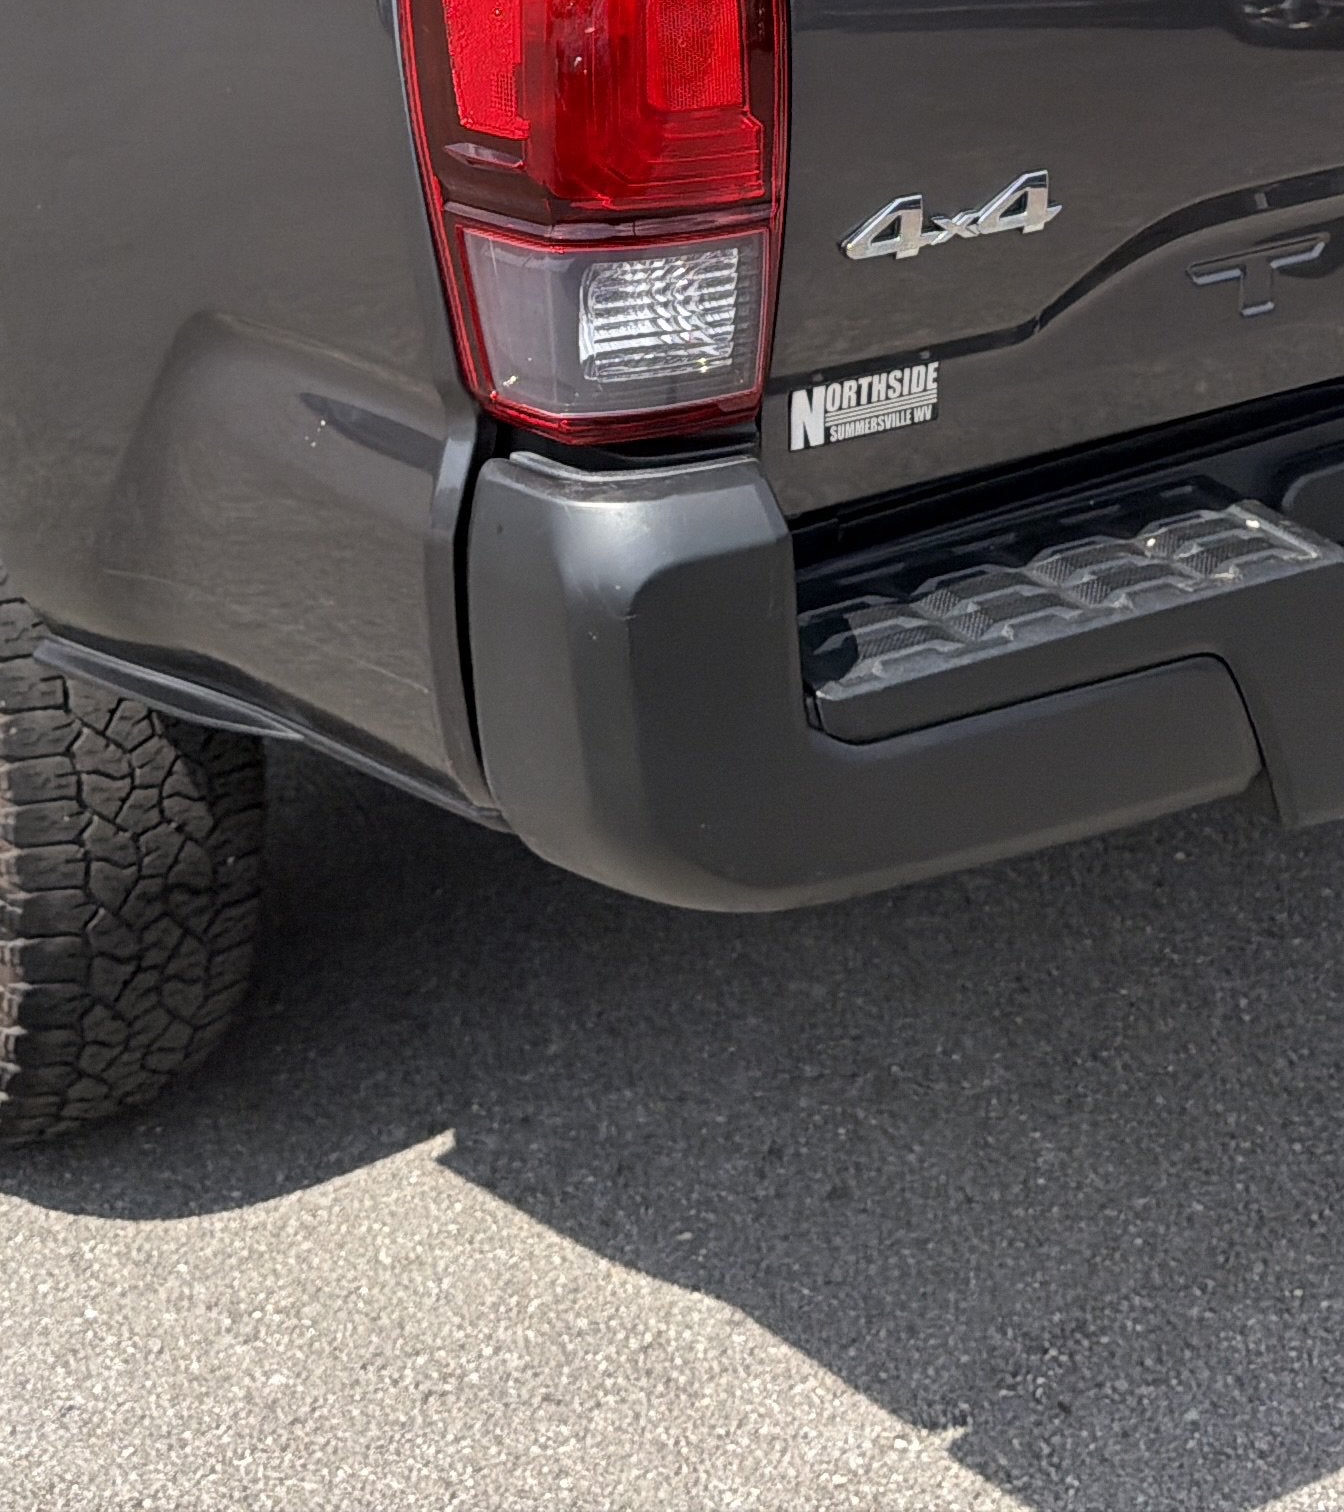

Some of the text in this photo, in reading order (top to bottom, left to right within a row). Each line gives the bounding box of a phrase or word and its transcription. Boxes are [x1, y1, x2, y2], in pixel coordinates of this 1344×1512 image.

[790, 361, 939, 451] NORTHSIDE
[829, 405, 934, 443] SUMMERSVILLE WV
